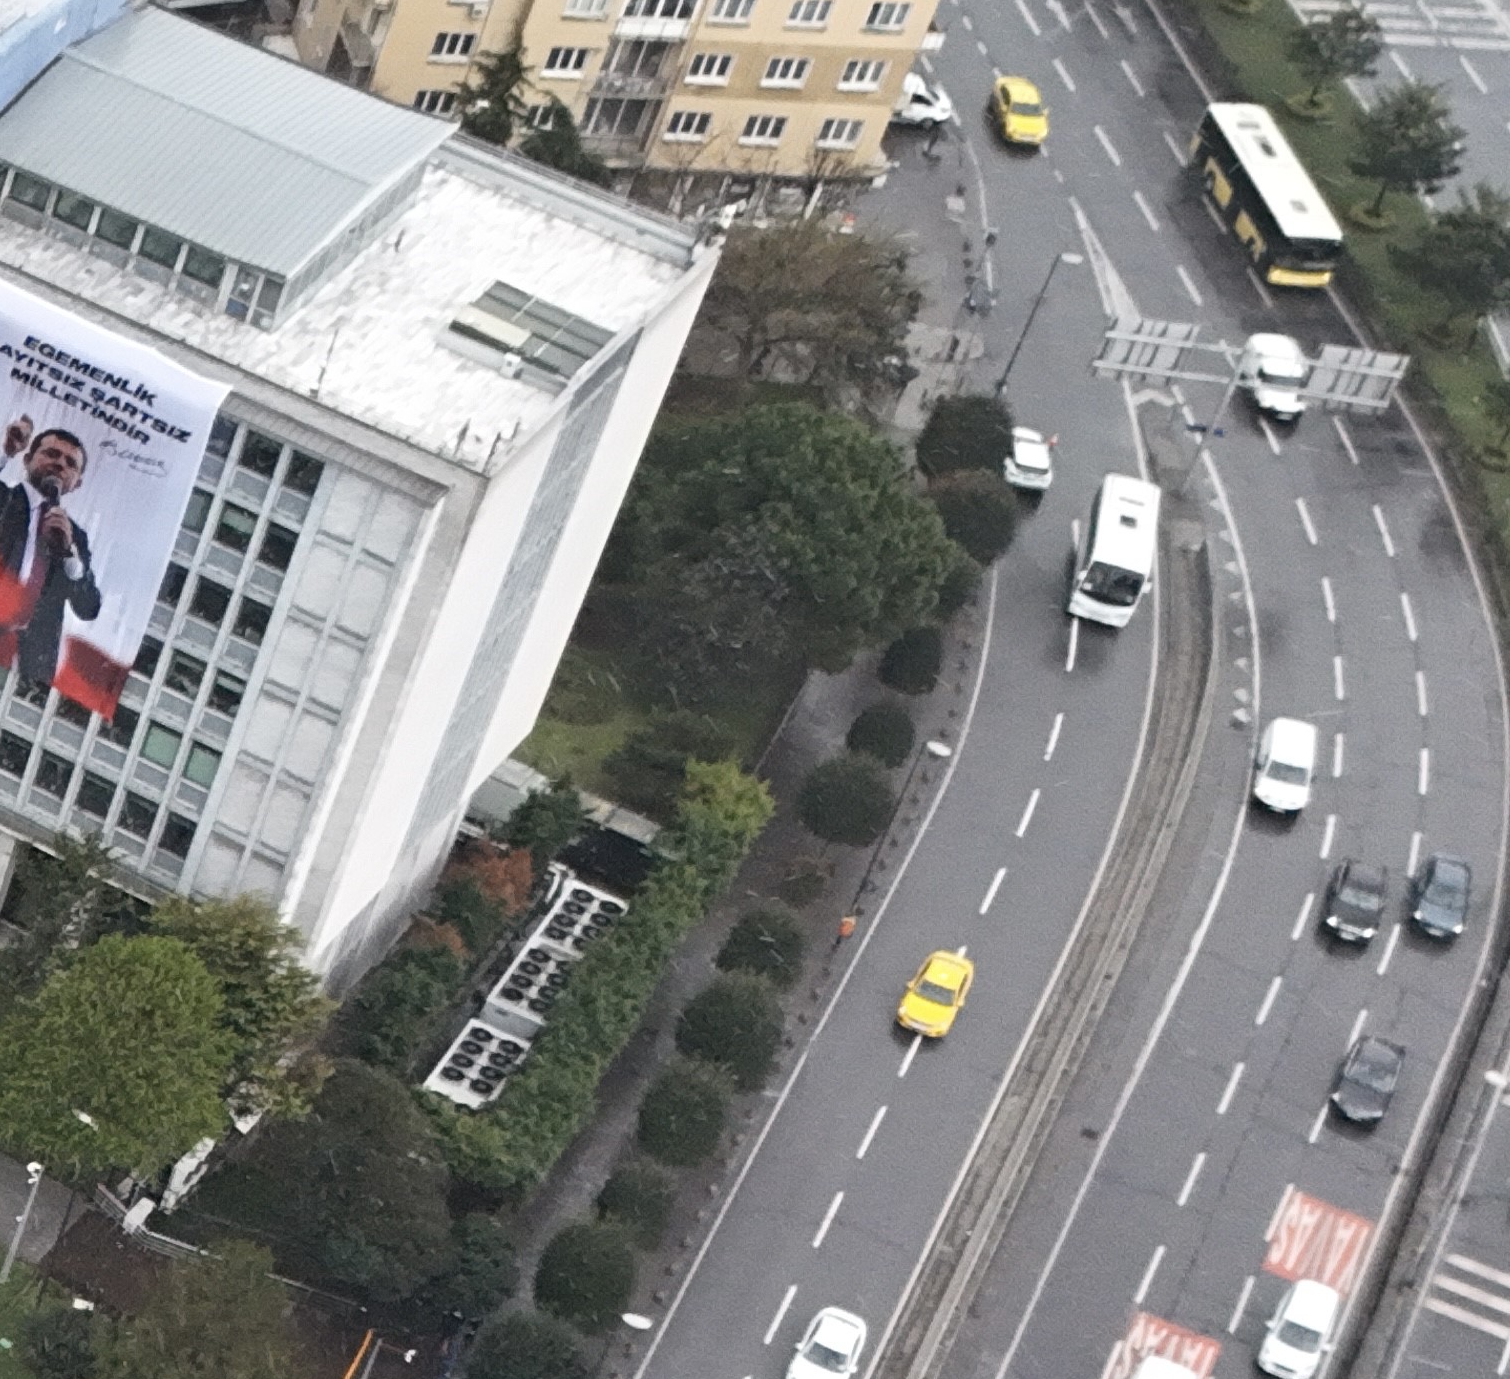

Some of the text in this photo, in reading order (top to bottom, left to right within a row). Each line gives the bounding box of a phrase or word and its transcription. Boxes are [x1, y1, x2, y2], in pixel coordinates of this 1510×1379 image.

[10, 367, 151, 445] MİLLETİNDİR
[23, 335, 158, 408] EGEMENLİK
[90, 386, 192, 444] ŞARTSIZ
